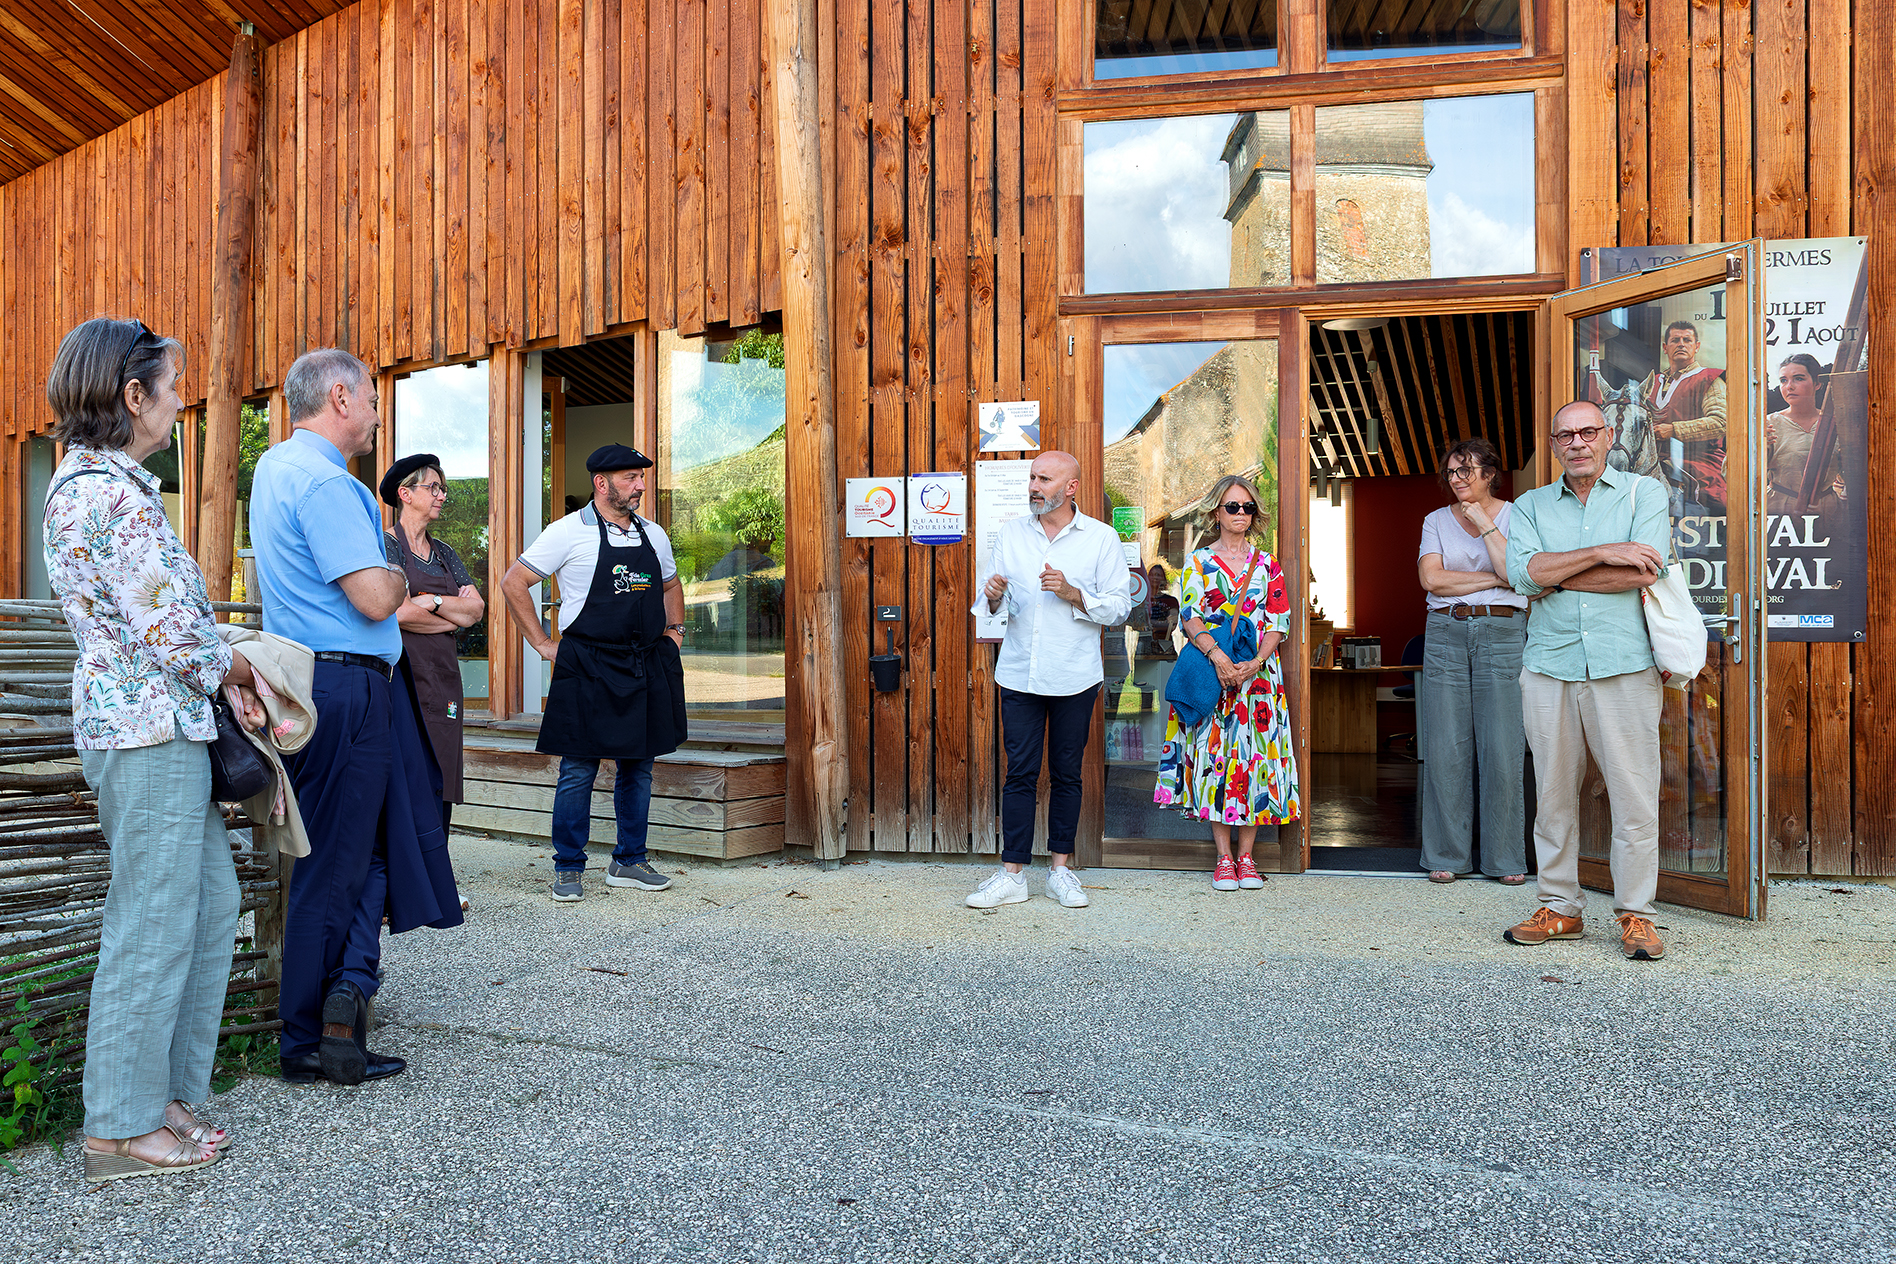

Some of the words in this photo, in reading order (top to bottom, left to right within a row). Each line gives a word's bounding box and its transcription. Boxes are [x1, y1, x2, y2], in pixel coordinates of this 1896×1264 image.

[1615, 257, 1641, 274] LA
[1694, 313, 1707, 321] DU
[1804, 324, 1858, 346] AOÛT
[912, 517, 959, 525] QUALITÉ
